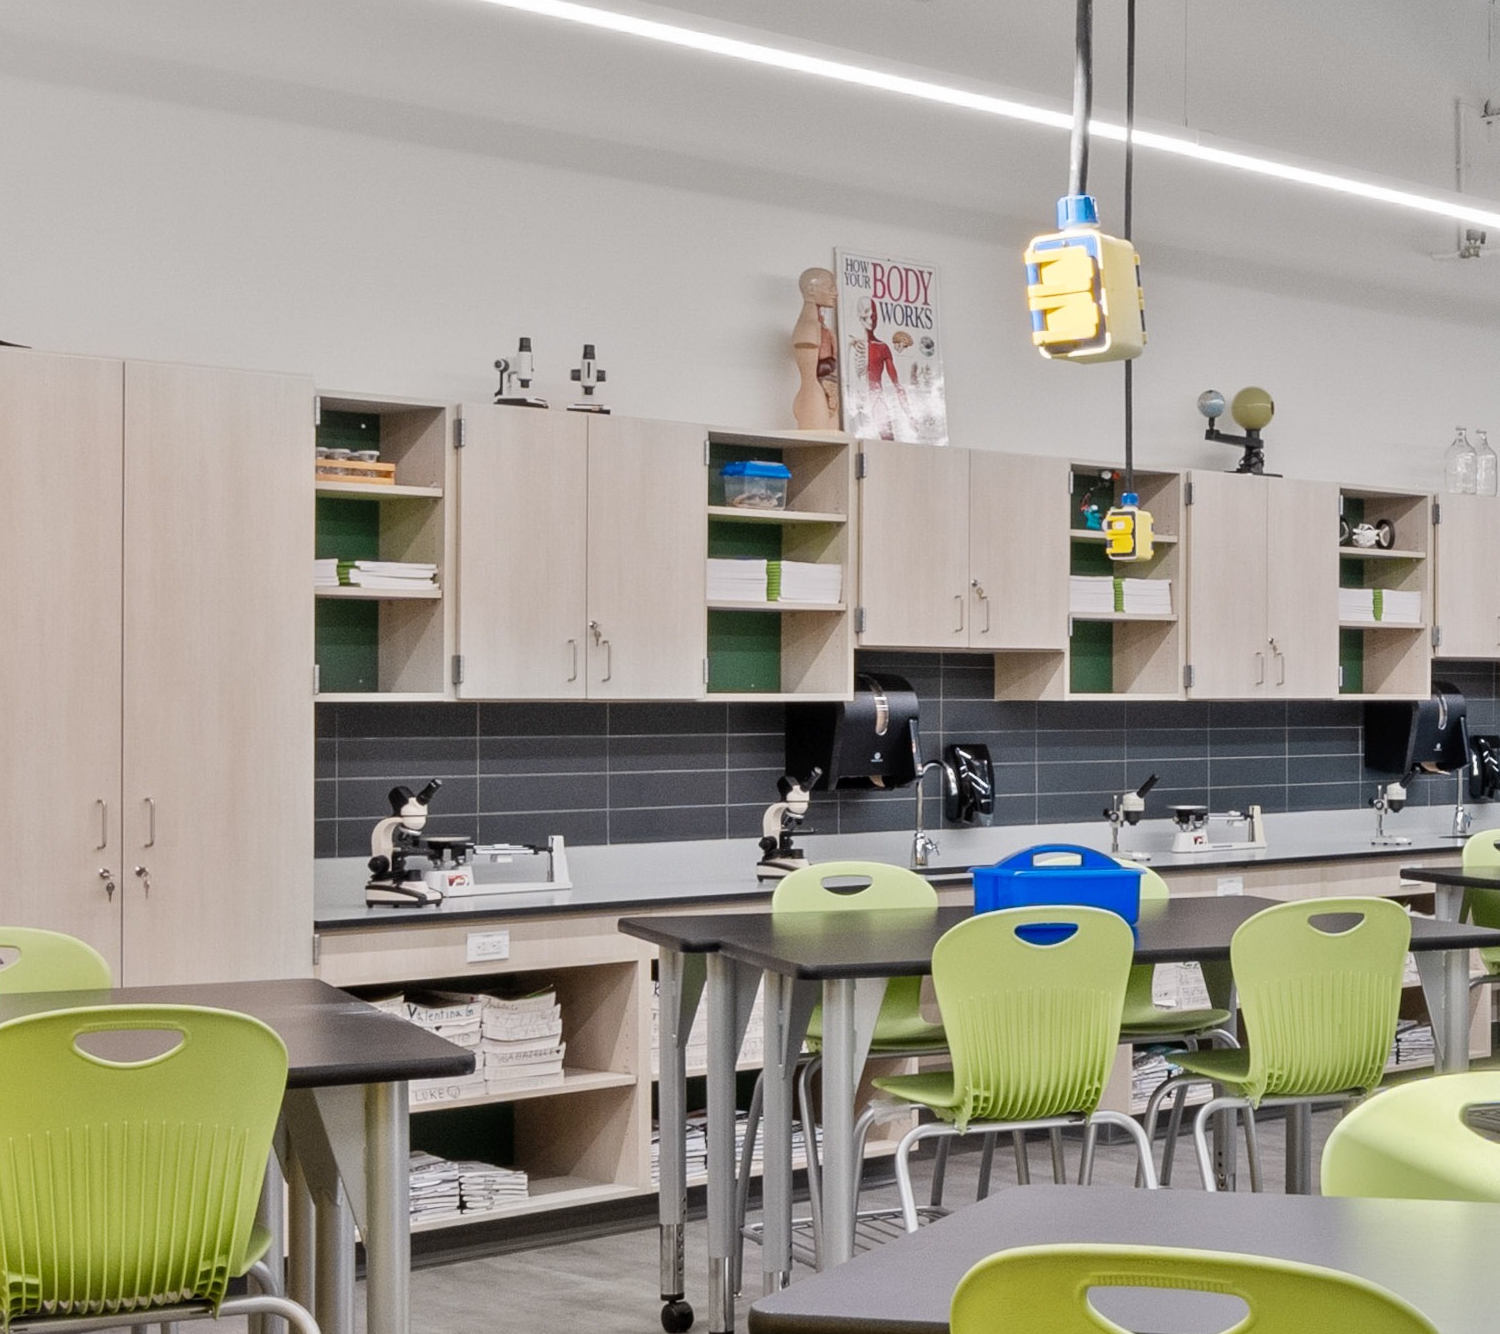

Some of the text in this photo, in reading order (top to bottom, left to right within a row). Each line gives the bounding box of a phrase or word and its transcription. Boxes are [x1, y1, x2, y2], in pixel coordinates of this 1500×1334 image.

[845, 257, 869, 274] HOW
[844, 272, 871, 289] YOUR
[871, 262, 933, 306] BODY
[879, 301, 933, 330] WORKS
[407, 1004, 462, 1022] Valentina
[415, 1087, 444, 1102] LUKE
